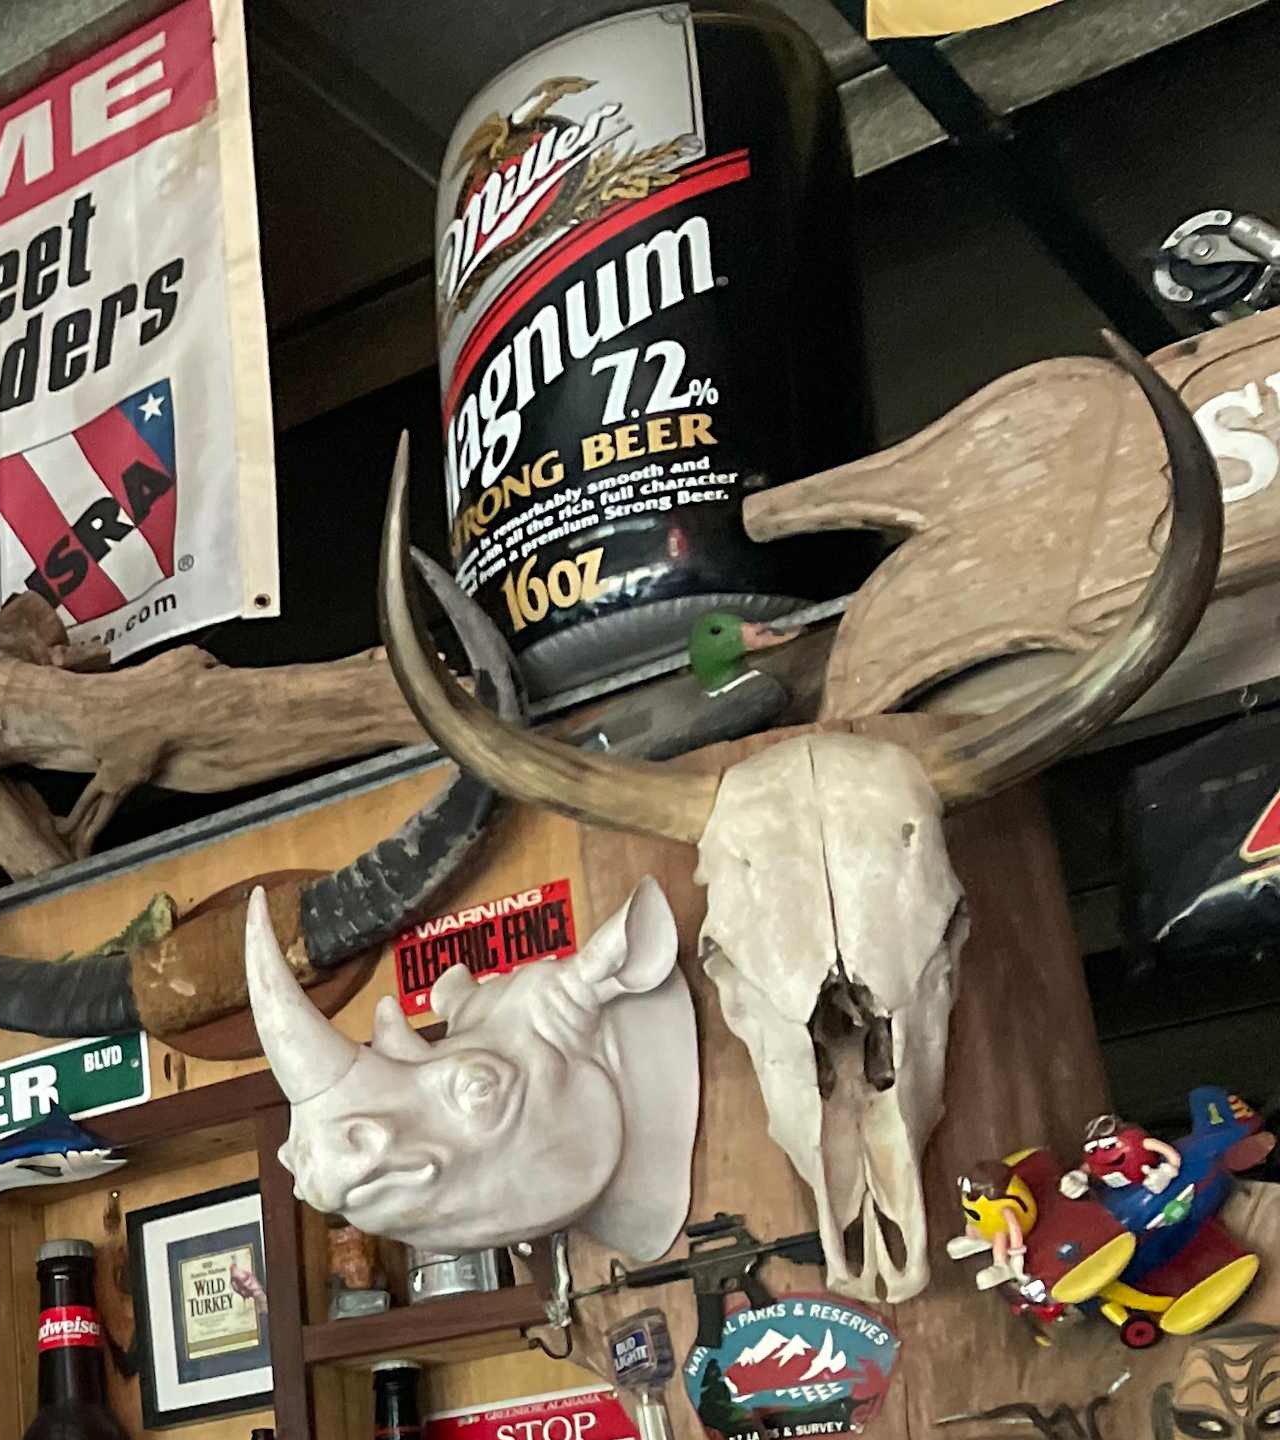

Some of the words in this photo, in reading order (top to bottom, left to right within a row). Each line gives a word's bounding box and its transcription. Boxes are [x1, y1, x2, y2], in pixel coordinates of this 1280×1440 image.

[591, 340, 718, 426] 7.2%
[506, 528, 523, 548] all
[526, 514, 555, 535] the
[558, 497, 593, 518] rich
[600, 487, 634, 506] full
[640, 472, 739, 495] character
[83, 1046, 123, 1074] BLVD
[194, 1277, 225, 1298] WILD
[188, 1294, 233, 1317] TURKEY
